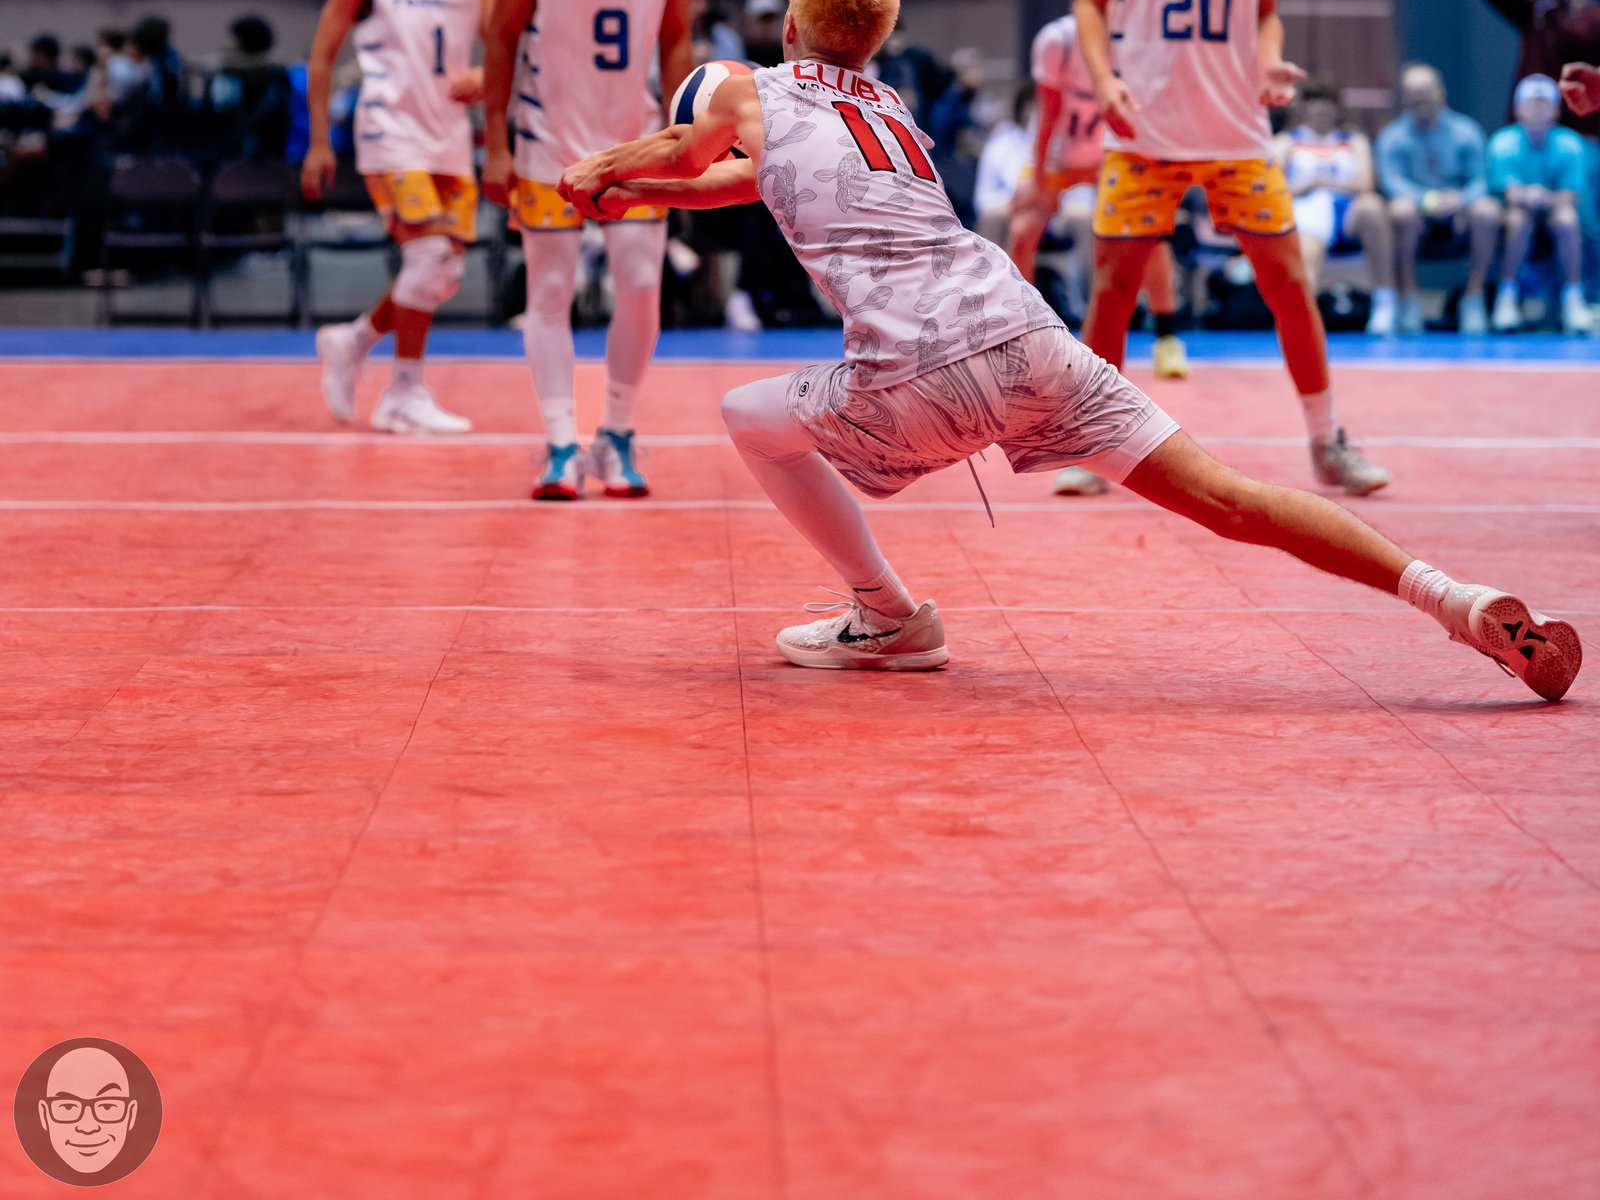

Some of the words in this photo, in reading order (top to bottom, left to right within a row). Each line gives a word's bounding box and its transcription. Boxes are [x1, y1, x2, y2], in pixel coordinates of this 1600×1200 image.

[433, 25, 446, 77] 1
[594, 7, 630, 72] 9
[793, 63, 881, 102] CLUB
[831, 101, 937, 183] 11
